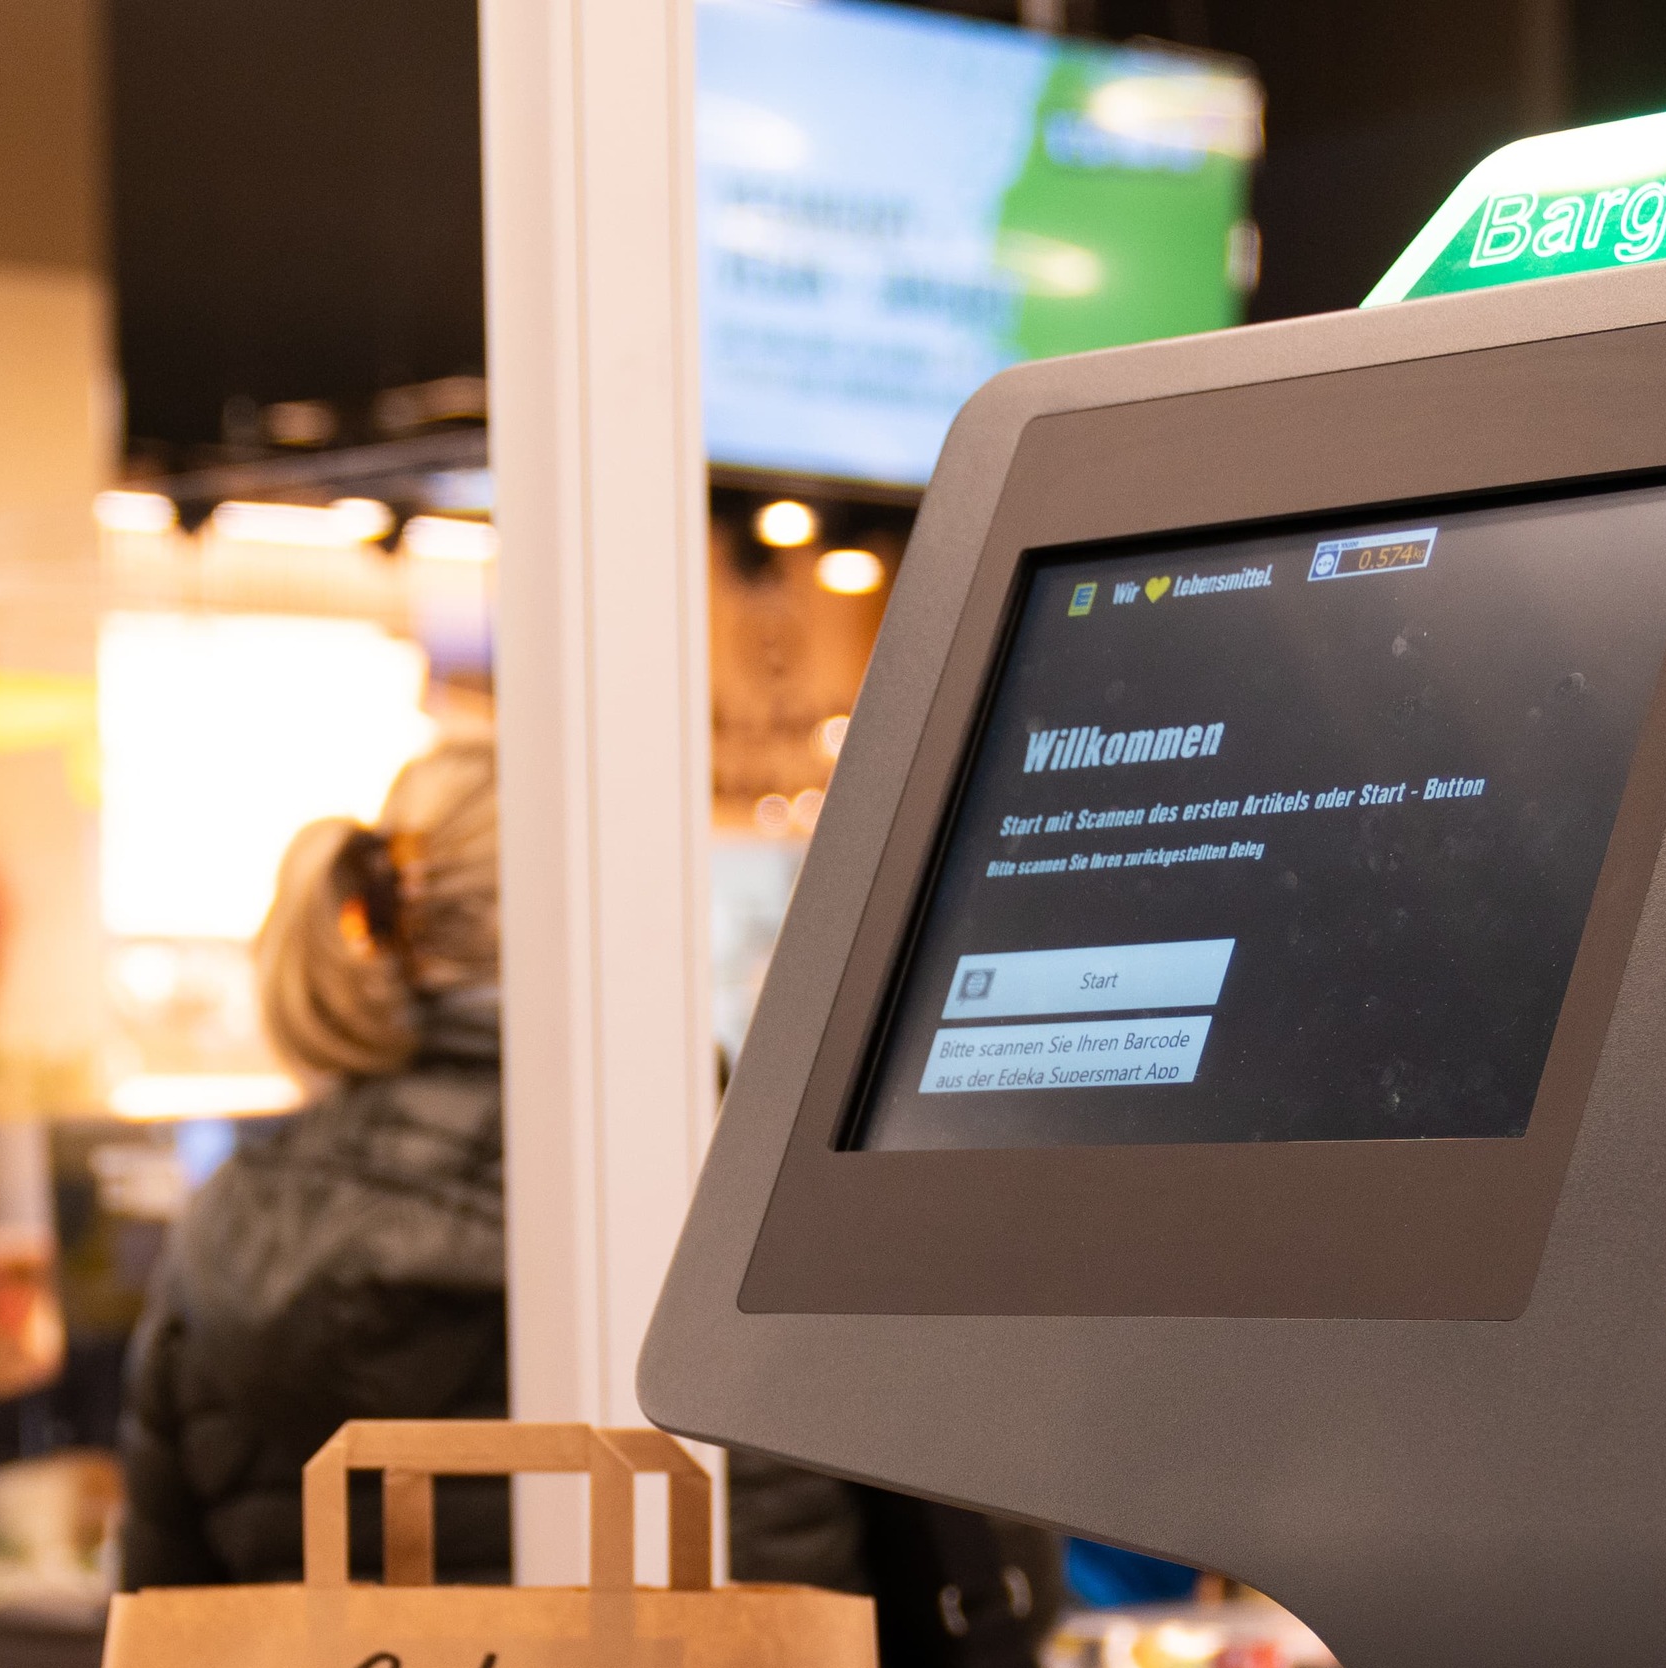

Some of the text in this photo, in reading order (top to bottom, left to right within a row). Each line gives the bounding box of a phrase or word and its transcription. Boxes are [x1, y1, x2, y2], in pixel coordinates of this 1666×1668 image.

[1112, 581, 1141, 605] Wir
[1023, 722, 1225, 773] Willkommen
[1000, 814, 1043, 836] Start
[1044, 811, 1074, 833] mit
[1075, 808, 1146, 830] Scannen
[1148, 802, 1179, 825] des
[1182, 799, 1239, 821] ersten
[1241, 790, 1309, 816] Artikels
[1314, 787, 1355, 810] oder
[1359, 783, 1406, 806] Start
[1423, 777, 1485, 800] Button
[986, 841, 1265, 878] Bitte scannen Sie Ihren zurückgestellten Beleg
[1080, 972, 1119, 990] Start
[939, 1030, 1190, 1059] Bitte scannen Sie Ihren Barcode
[936, 1073, 962, 1088] aus
[966, 1070, 995, 1088] der
[997, 1068, 1045, 1086] Edeka
